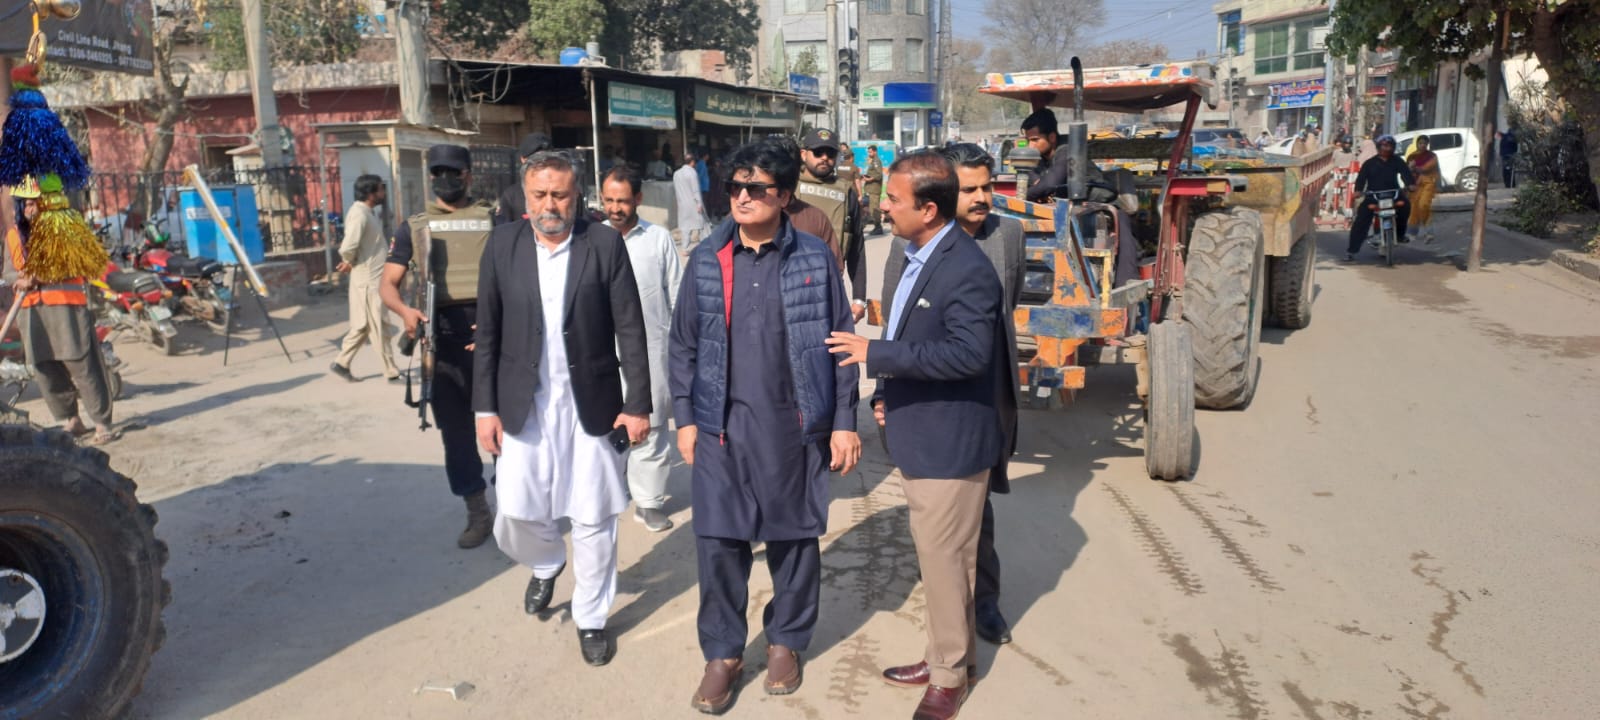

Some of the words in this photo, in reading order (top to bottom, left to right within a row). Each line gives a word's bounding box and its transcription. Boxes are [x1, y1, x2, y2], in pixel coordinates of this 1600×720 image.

[58, 29, 75, 42] Civil
[76, 32, 91, 46] Line
[802, 185, 845, 202] POLICE
[430, 220, 490, 232] POLICE
